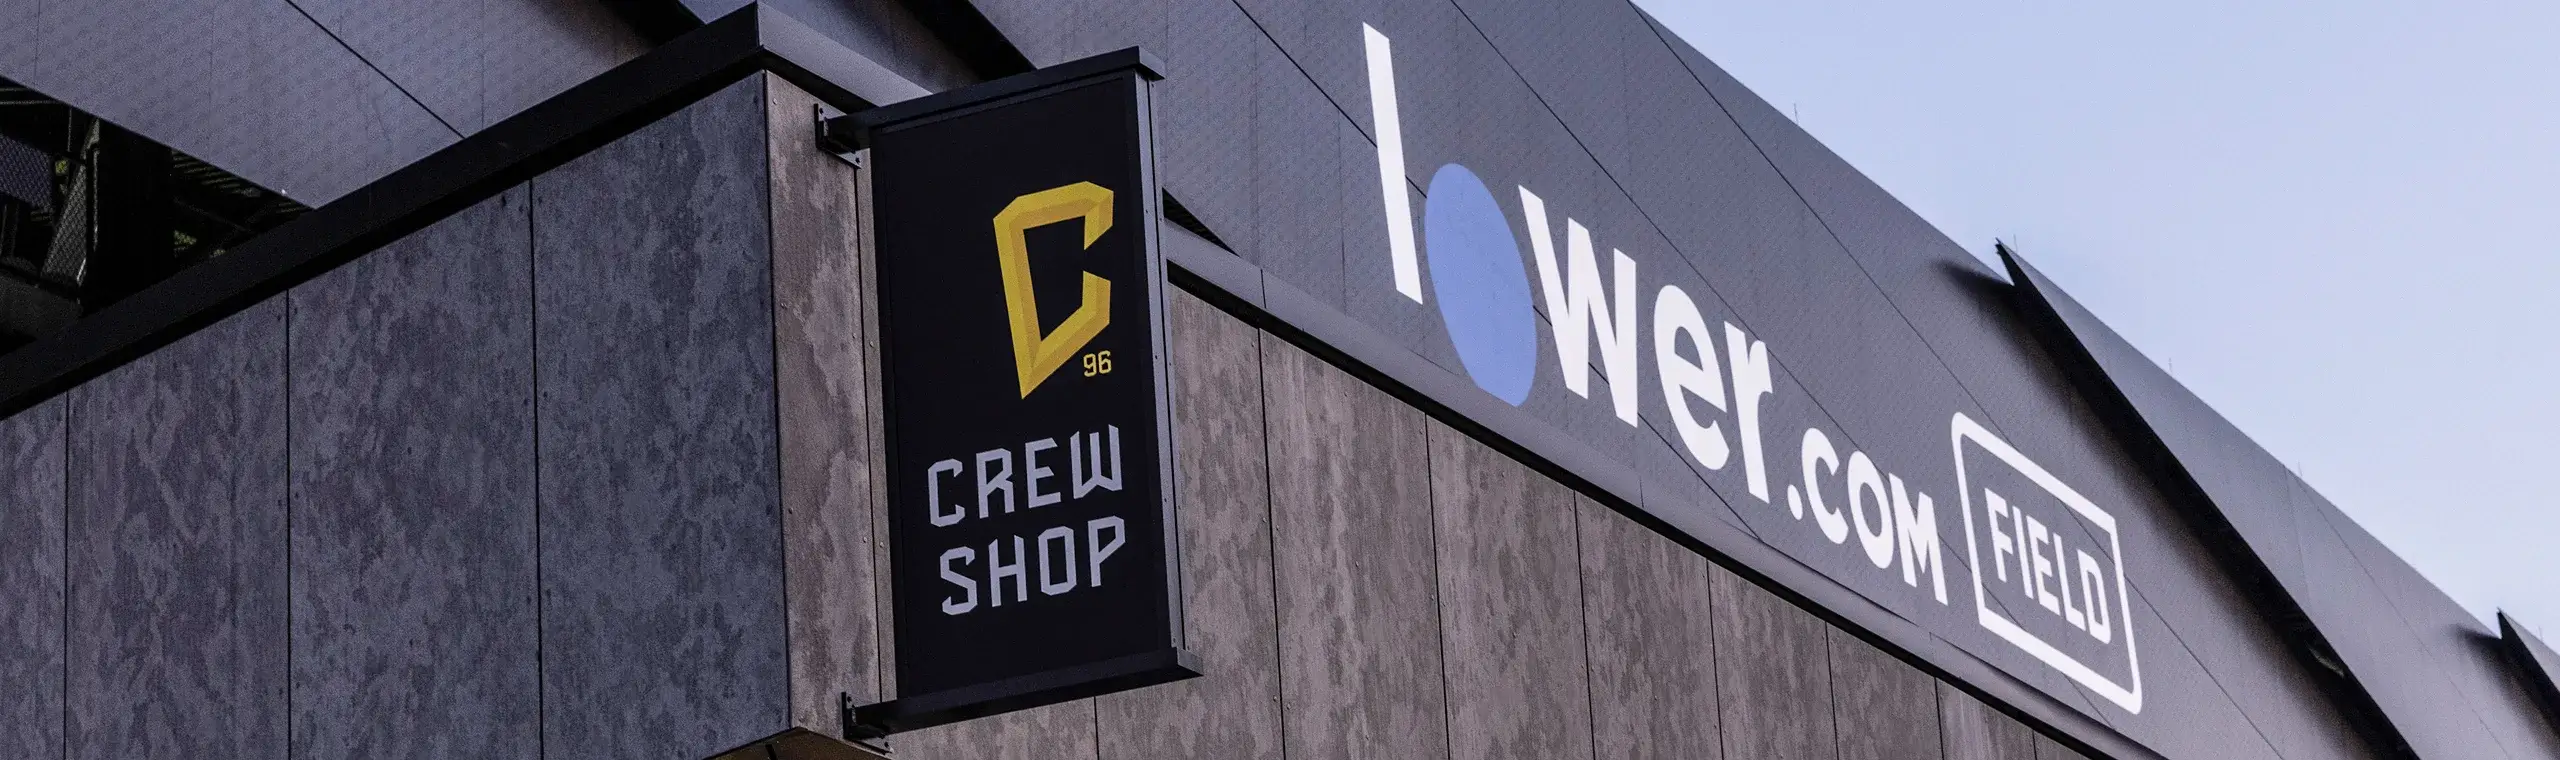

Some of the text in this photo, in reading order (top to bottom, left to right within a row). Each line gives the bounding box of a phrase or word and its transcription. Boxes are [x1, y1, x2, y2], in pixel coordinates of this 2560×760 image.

[1083, 350, 1112, 378] 96
[927, 424, 1123, 528] CREW
[939, 515, 1126, 616] SHOP
[1984, 487, 2112, 645] FIELD
